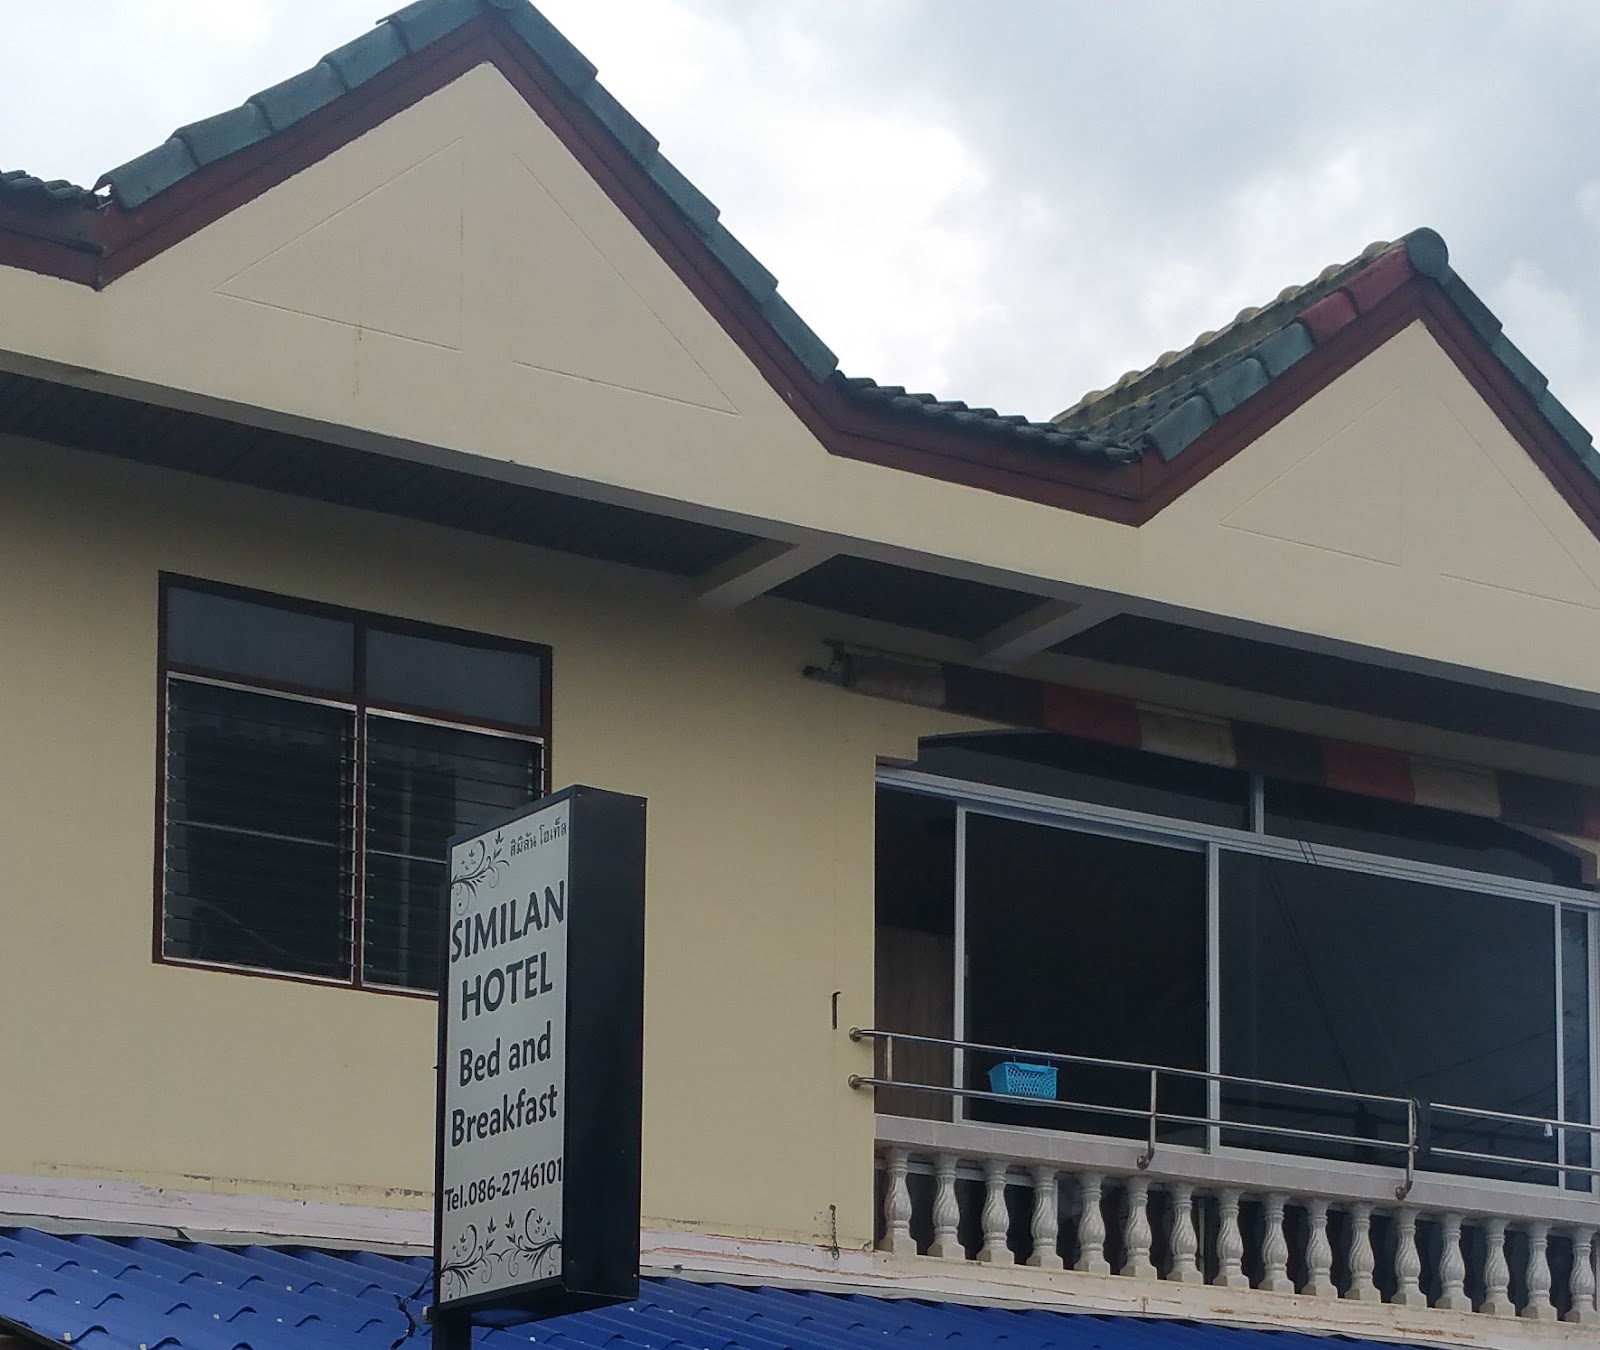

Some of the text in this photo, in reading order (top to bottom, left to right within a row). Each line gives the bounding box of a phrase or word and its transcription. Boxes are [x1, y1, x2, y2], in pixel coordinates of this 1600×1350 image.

[451, 880, 565, 963] SIMILAN
[461, 951, 553, 1021] HOTEL
[459, 1020, 551, 1087] Bed and
[451, 1084, 558, 1147] Breakfast
